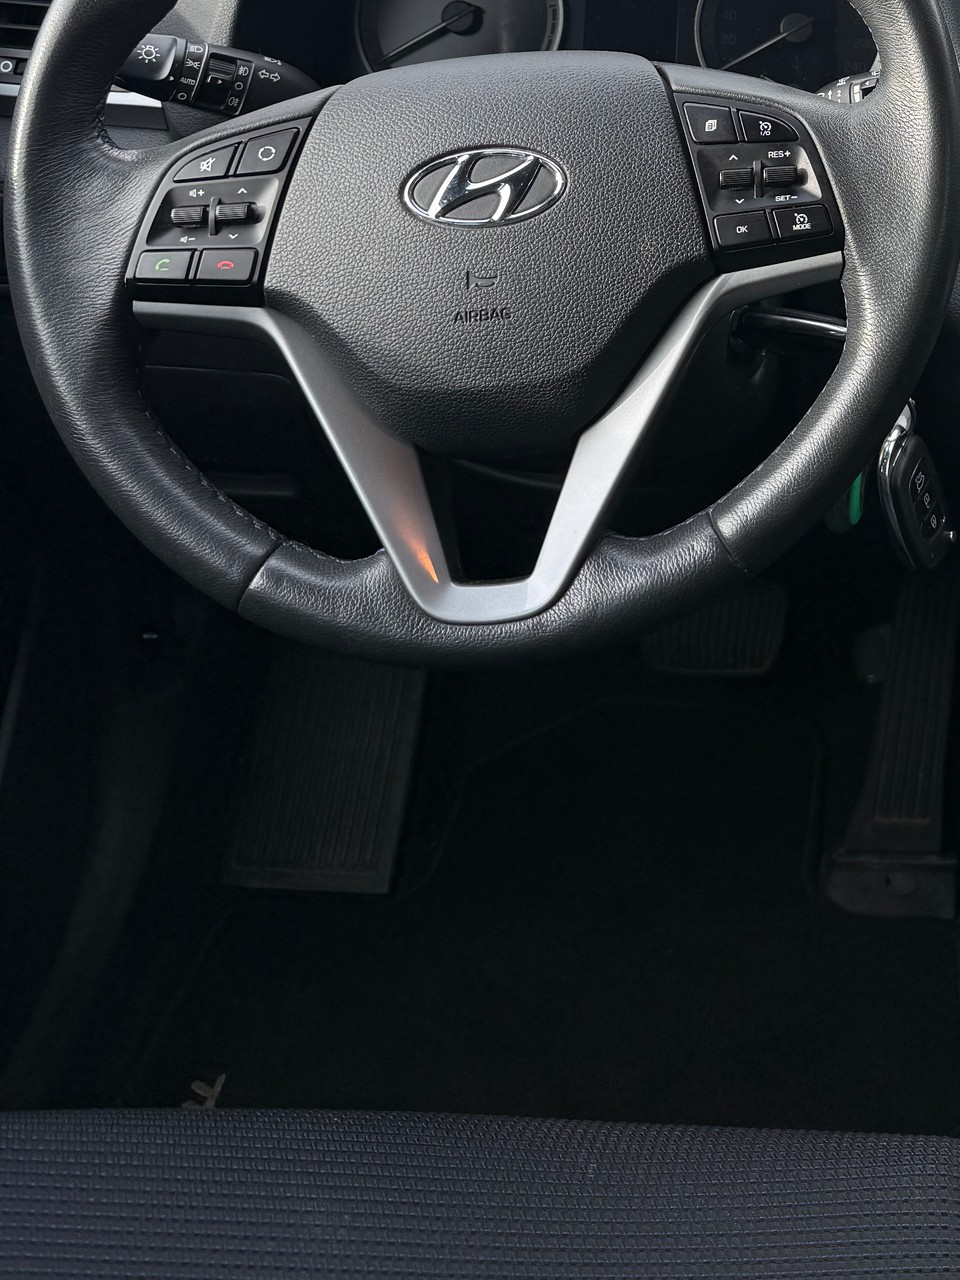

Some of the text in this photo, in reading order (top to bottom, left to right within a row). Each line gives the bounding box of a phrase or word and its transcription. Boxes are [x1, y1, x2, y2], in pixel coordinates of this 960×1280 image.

[720, 33, 737, 45] 20
[180, 77, 195, 85] AUTO
[736, 225, 749, 234] OK
[792, 223, 811, 231] MODE
[453, 308, 512, 324] AIRBAG
